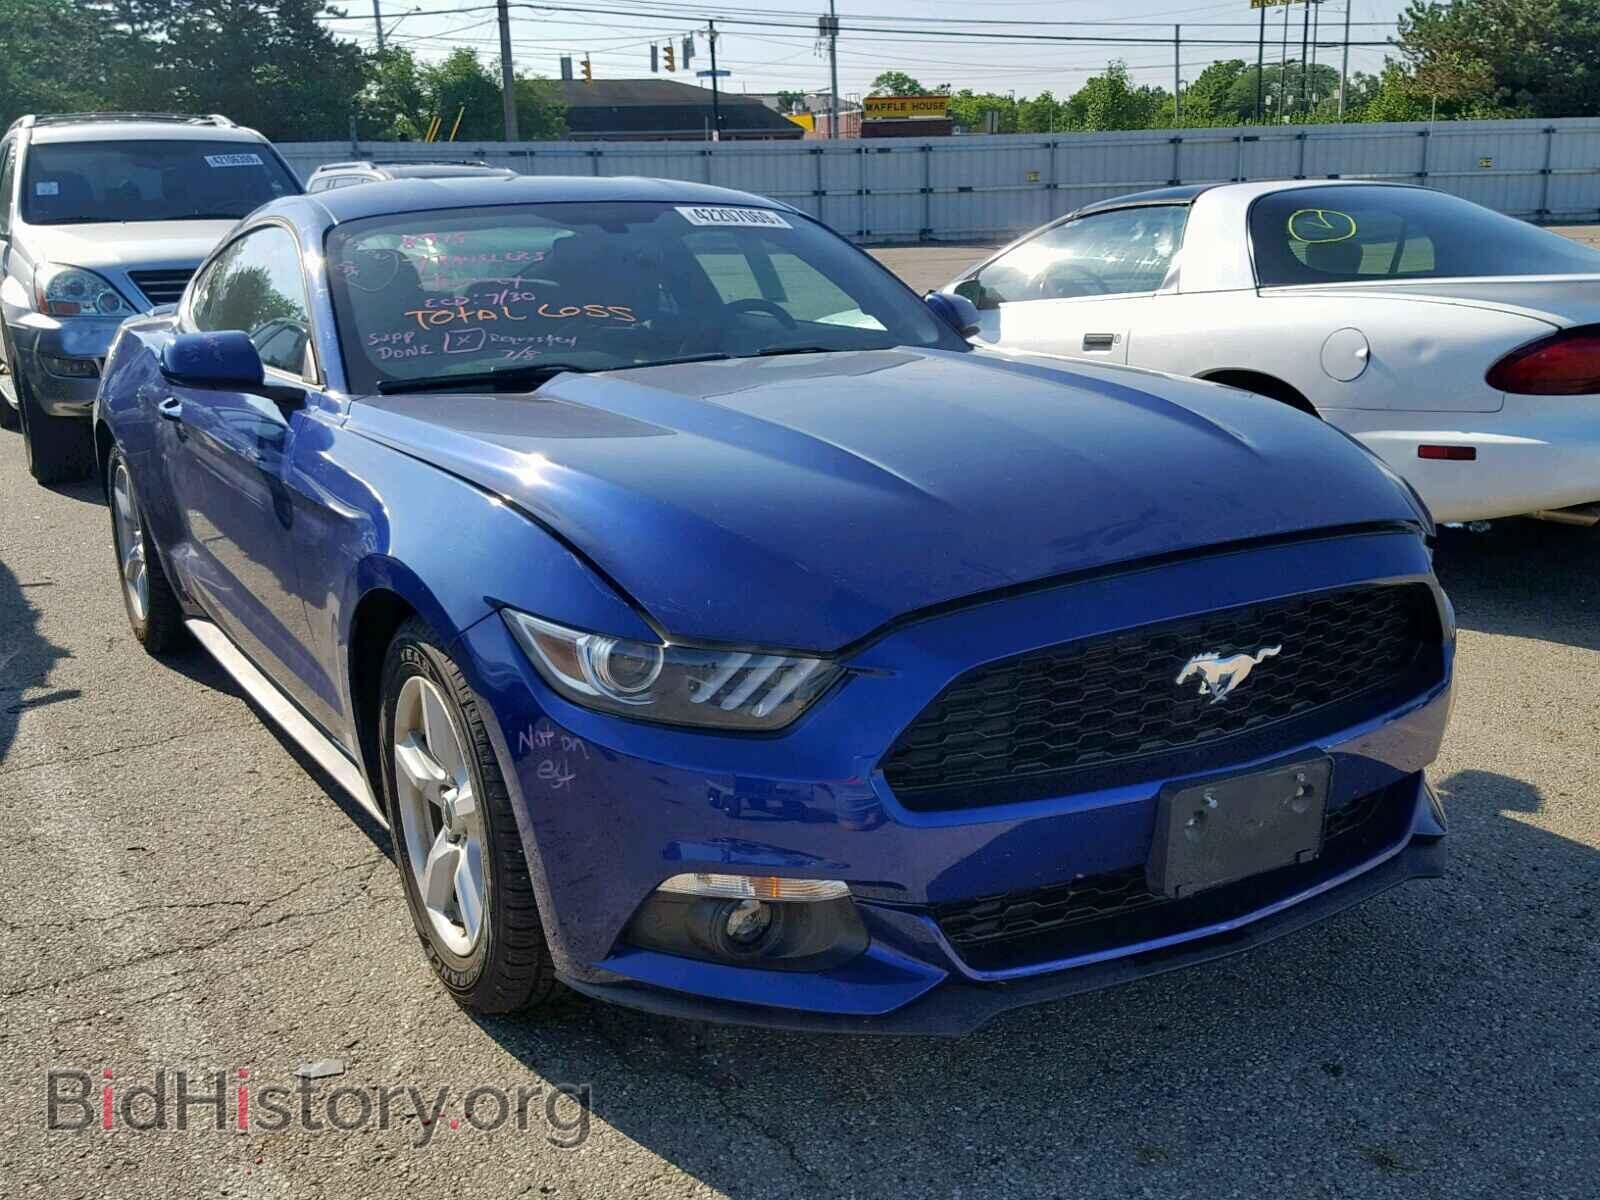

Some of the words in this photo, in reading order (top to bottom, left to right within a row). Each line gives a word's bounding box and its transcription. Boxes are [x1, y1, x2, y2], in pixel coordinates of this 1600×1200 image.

[865, 102, 906, 112] WAFFLE
[911, 101, 945, 111] HOUSE
[484, 288, 536, 305] 7/30
[538, 303, 636, 322] LOSS
[377, 345, 433, 359] DONE
[518, 723, 555, 753] Not
[560, 734, 590, 760] on
